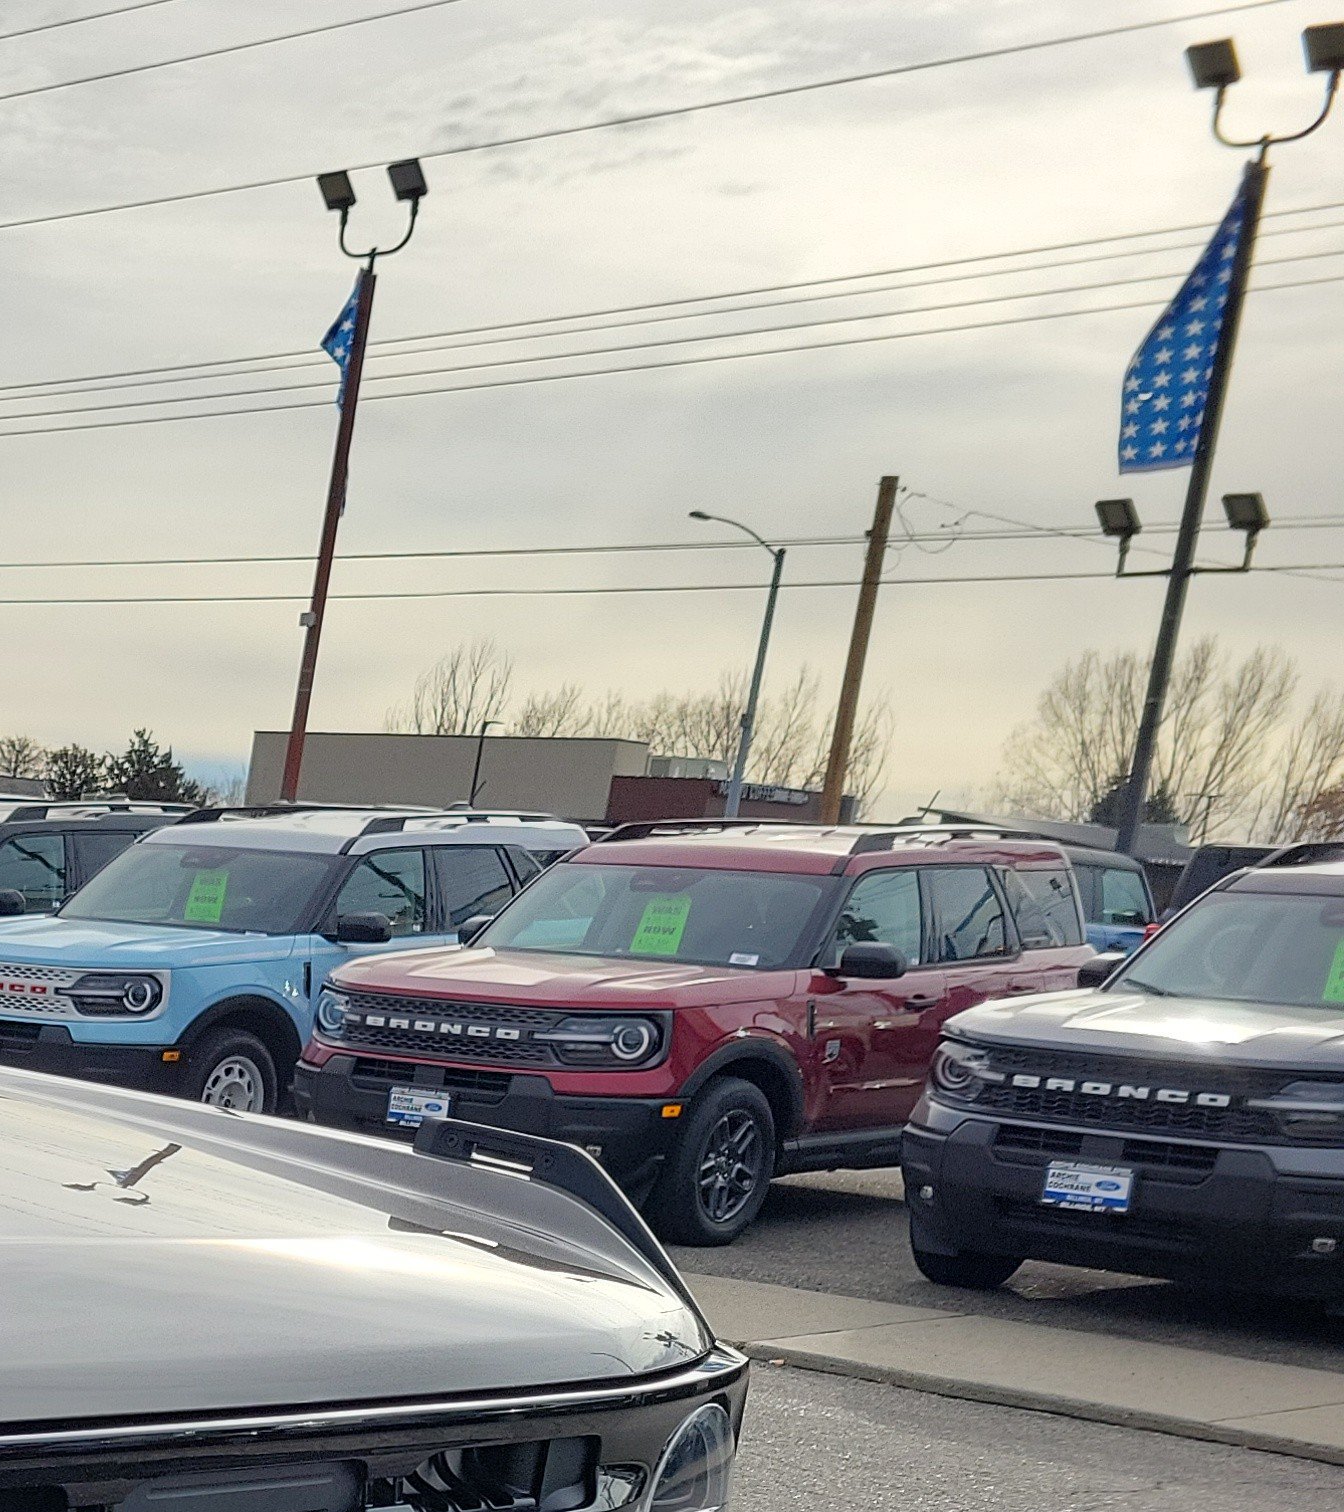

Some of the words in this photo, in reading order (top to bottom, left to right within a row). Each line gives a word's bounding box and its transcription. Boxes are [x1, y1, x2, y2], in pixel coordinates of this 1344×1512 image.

[365, 1014, 520, 1041] BRONCO
[1012, 1073, 1231, 1108] BRONCO
[1048, 1181, 1091, 1193] COCHRANE
